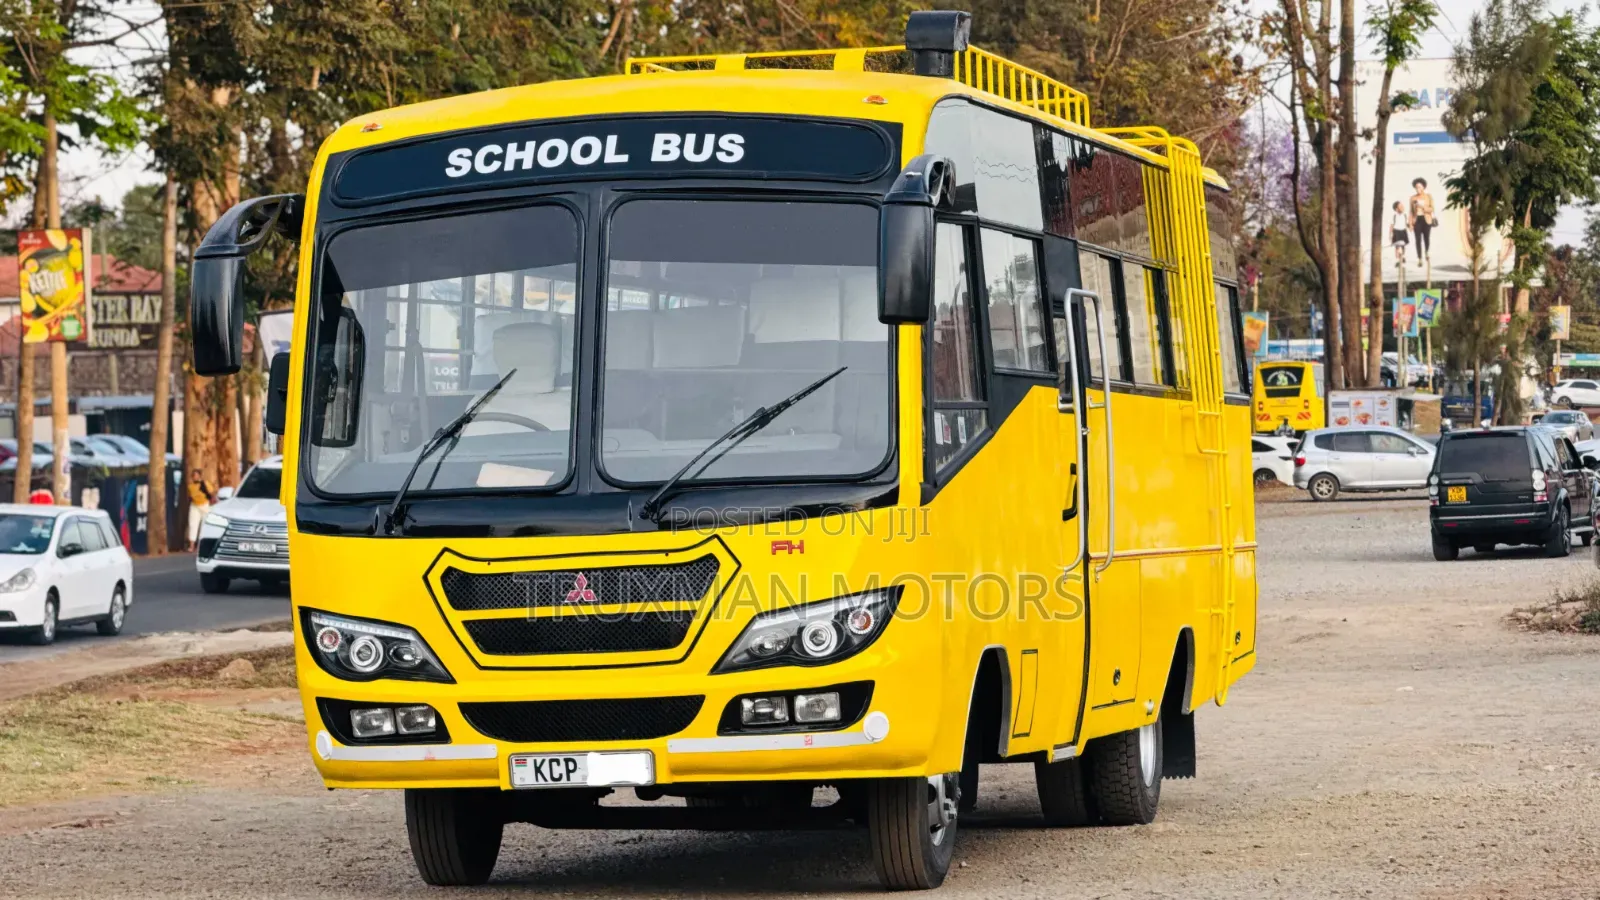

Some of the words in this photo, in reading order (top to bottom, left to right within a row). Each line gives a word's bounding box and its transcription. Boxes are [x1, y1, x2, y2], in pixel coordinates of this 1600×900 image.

[446, 134, 629, 178] SCHOOL
[650, 133, 745, 164] BUS
[130, 294, 163, 324] BAY
[771, 540, 804, 555] FH
[533, 757, 578, 783] KCP
